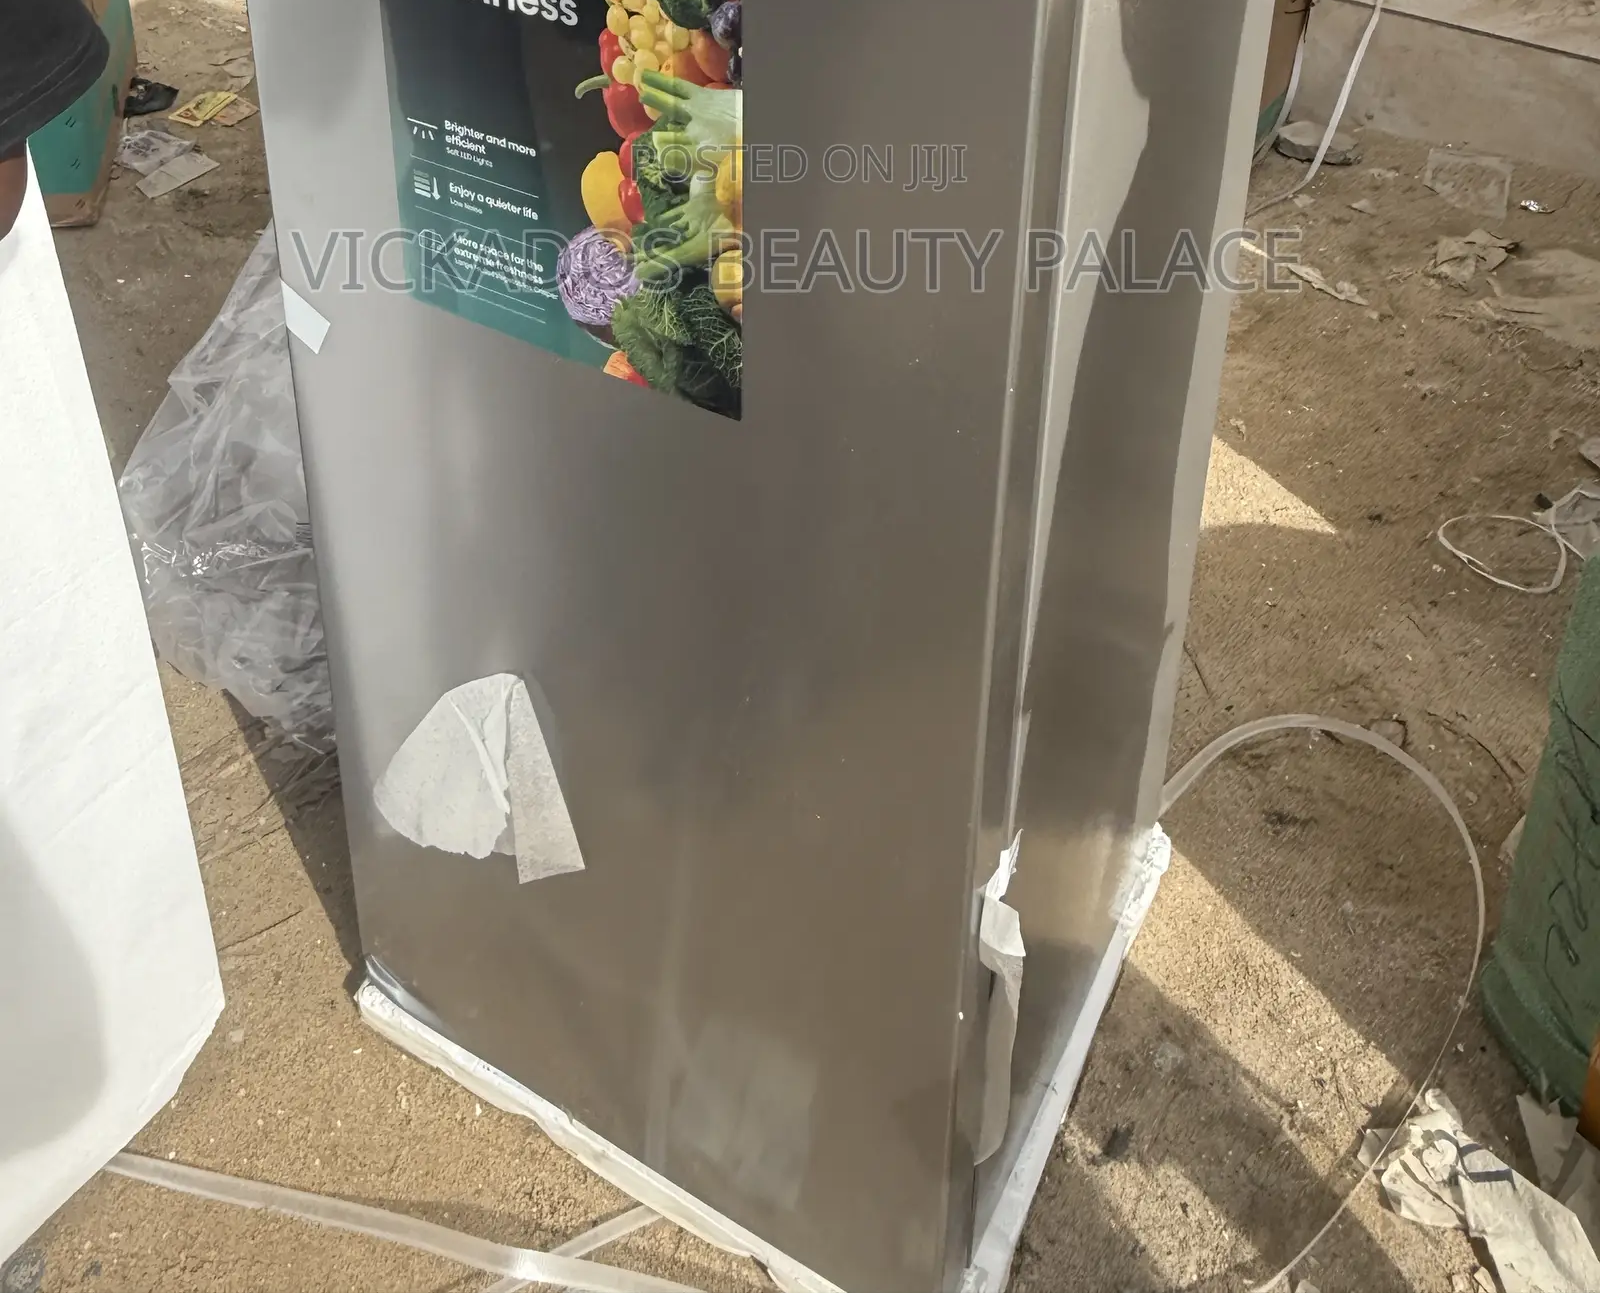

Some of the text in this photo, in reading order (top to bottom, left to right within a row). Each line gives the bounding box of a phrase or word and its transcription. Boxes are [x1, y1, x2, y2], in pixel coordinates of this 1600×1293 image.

[444, 119, 536, 157] Brighter and more
[445, 134, 486, 154] efficient
[449, 182, 538, 220] Enjoy a quieter life
[453, 233, 544, 272] More space for the
